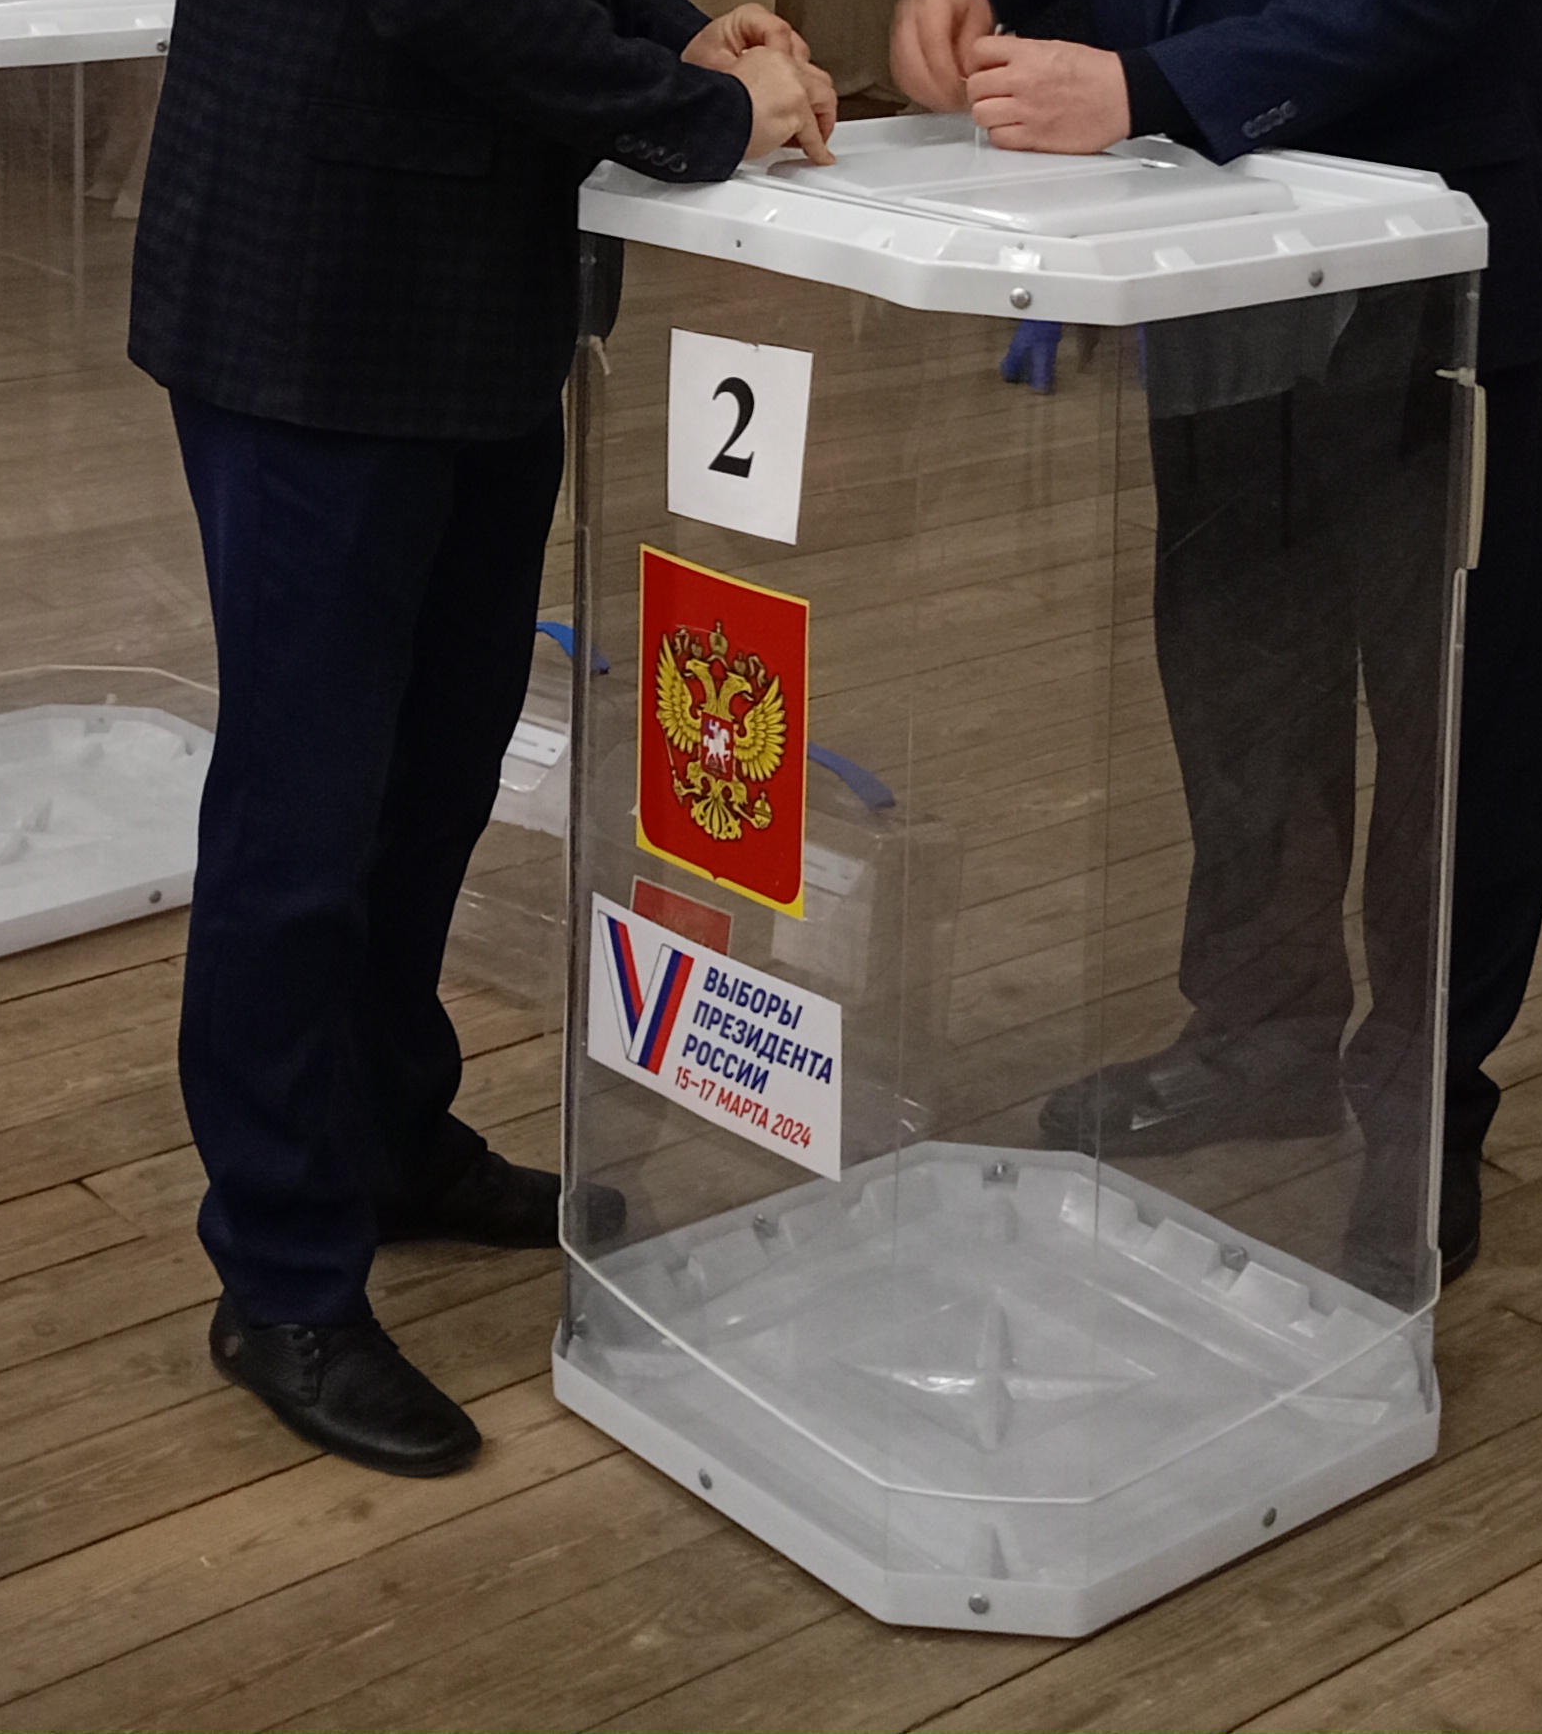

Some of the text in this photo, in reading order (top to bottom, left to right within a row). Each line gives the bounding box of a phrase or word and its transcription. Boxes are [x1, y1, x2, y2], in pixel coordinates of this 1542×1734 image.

[708, 376, 755, 479] 2
[703, 966, 803, 1030] ВЫБОРЫ
[682, 1033, 770, 1095] РОССИИ
[692, 1000, 834, 1085] ПРЕЗИДЕНТА
[716, 1087, 769, 1130] МАРТА
[771, 1113, 813, 1149] 2024
